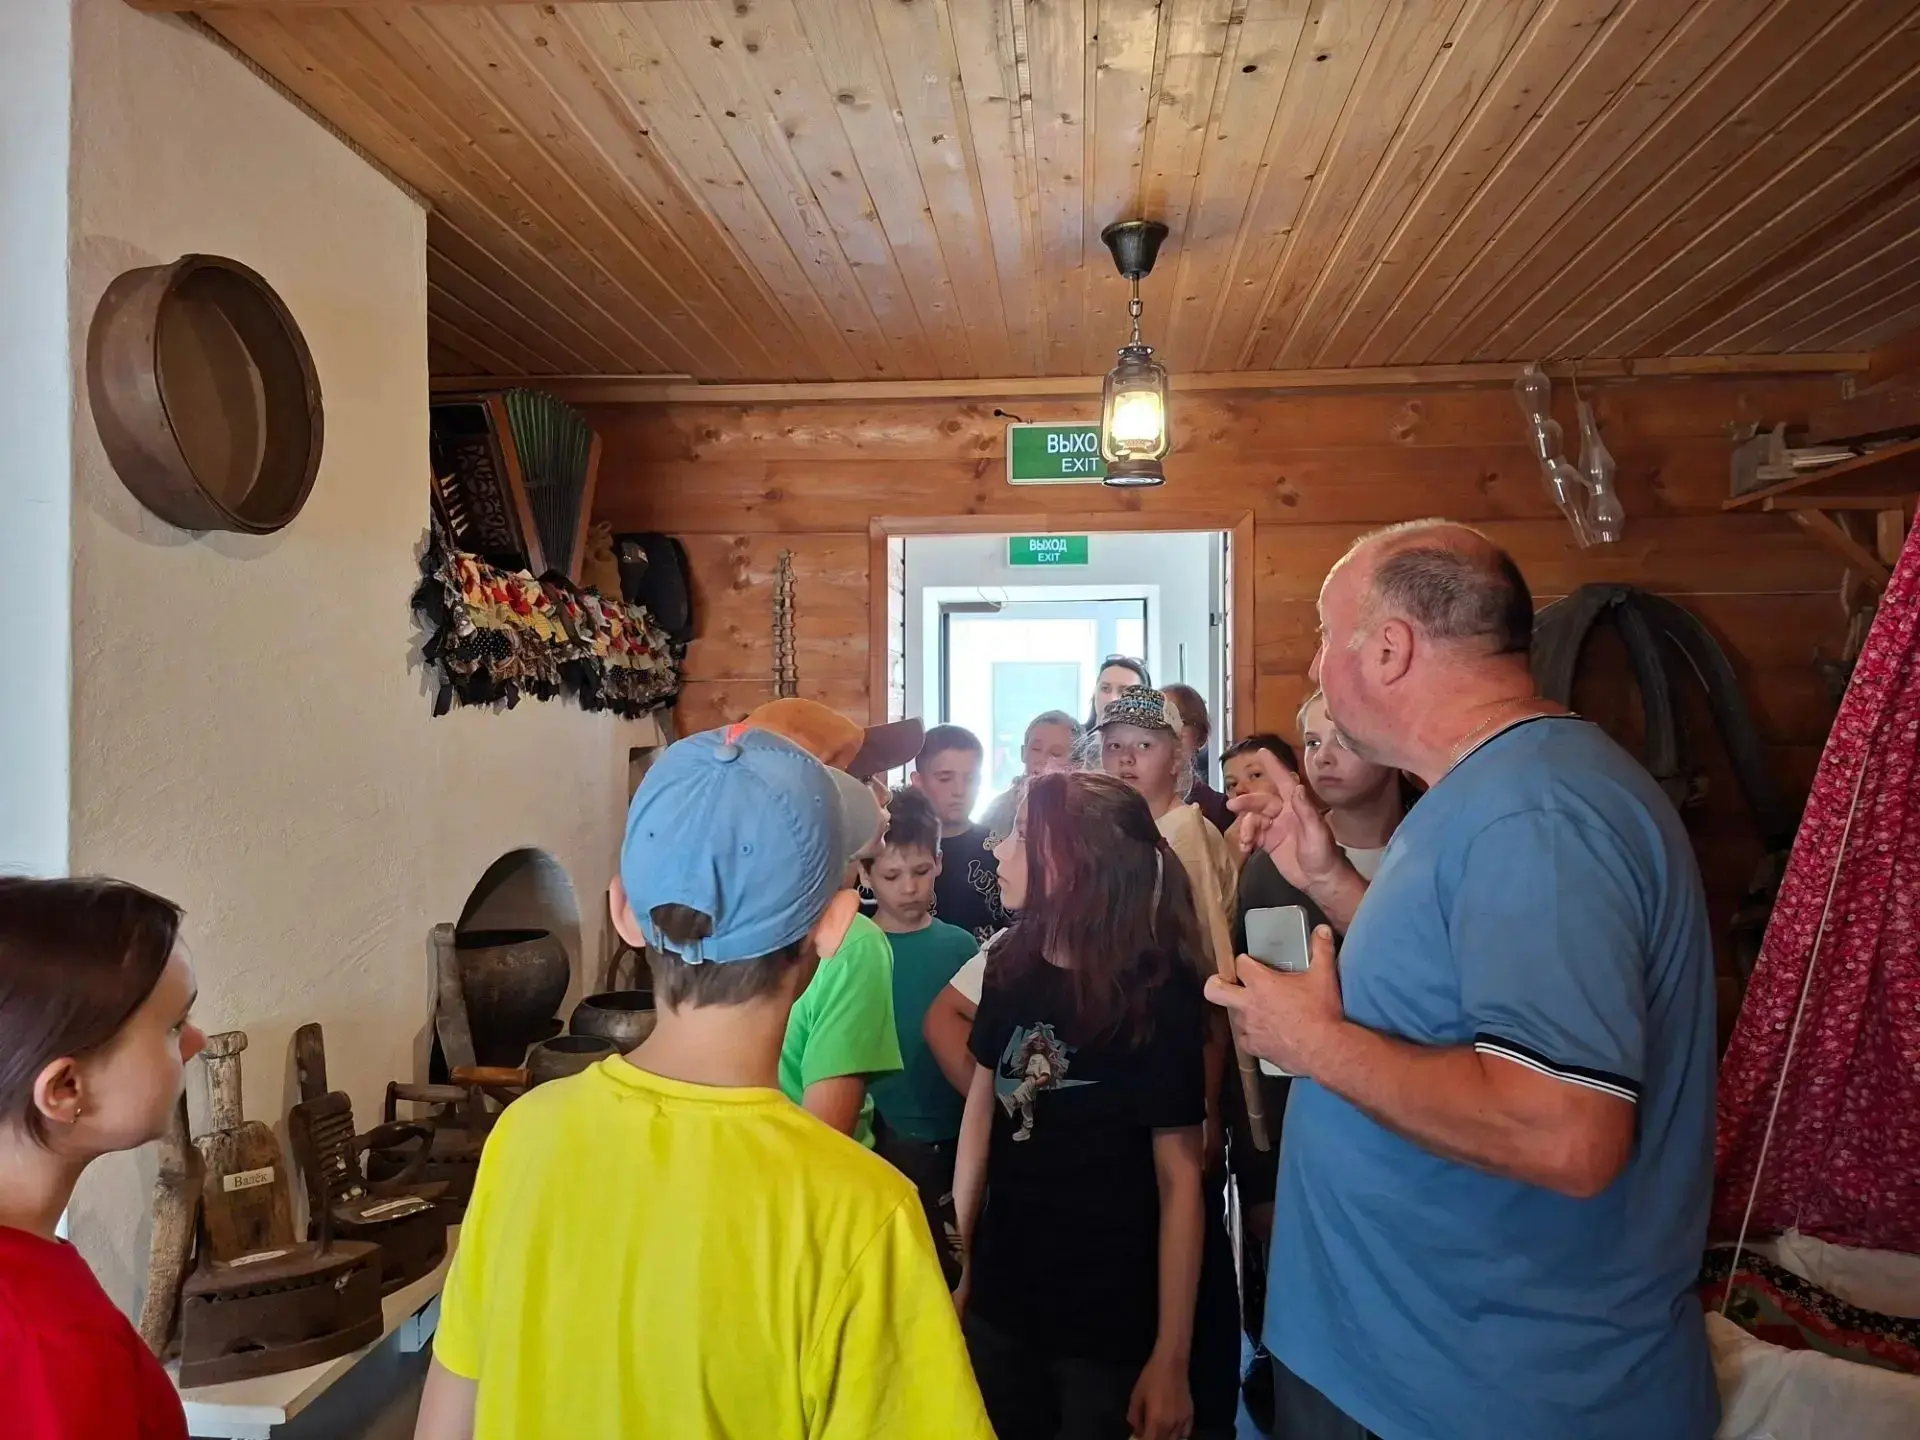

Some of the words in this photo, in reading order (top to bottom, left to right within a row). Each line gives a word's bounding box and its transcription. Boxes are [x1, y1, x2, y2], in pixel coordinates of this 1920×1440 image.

[1062, 457, 1099, 473] EXIT
[1029, 538, 1067, 552] ВЫХОД
[1037, 553, 1060, 562] EXIT
[233, 1171, 269, 1188] Валёк
